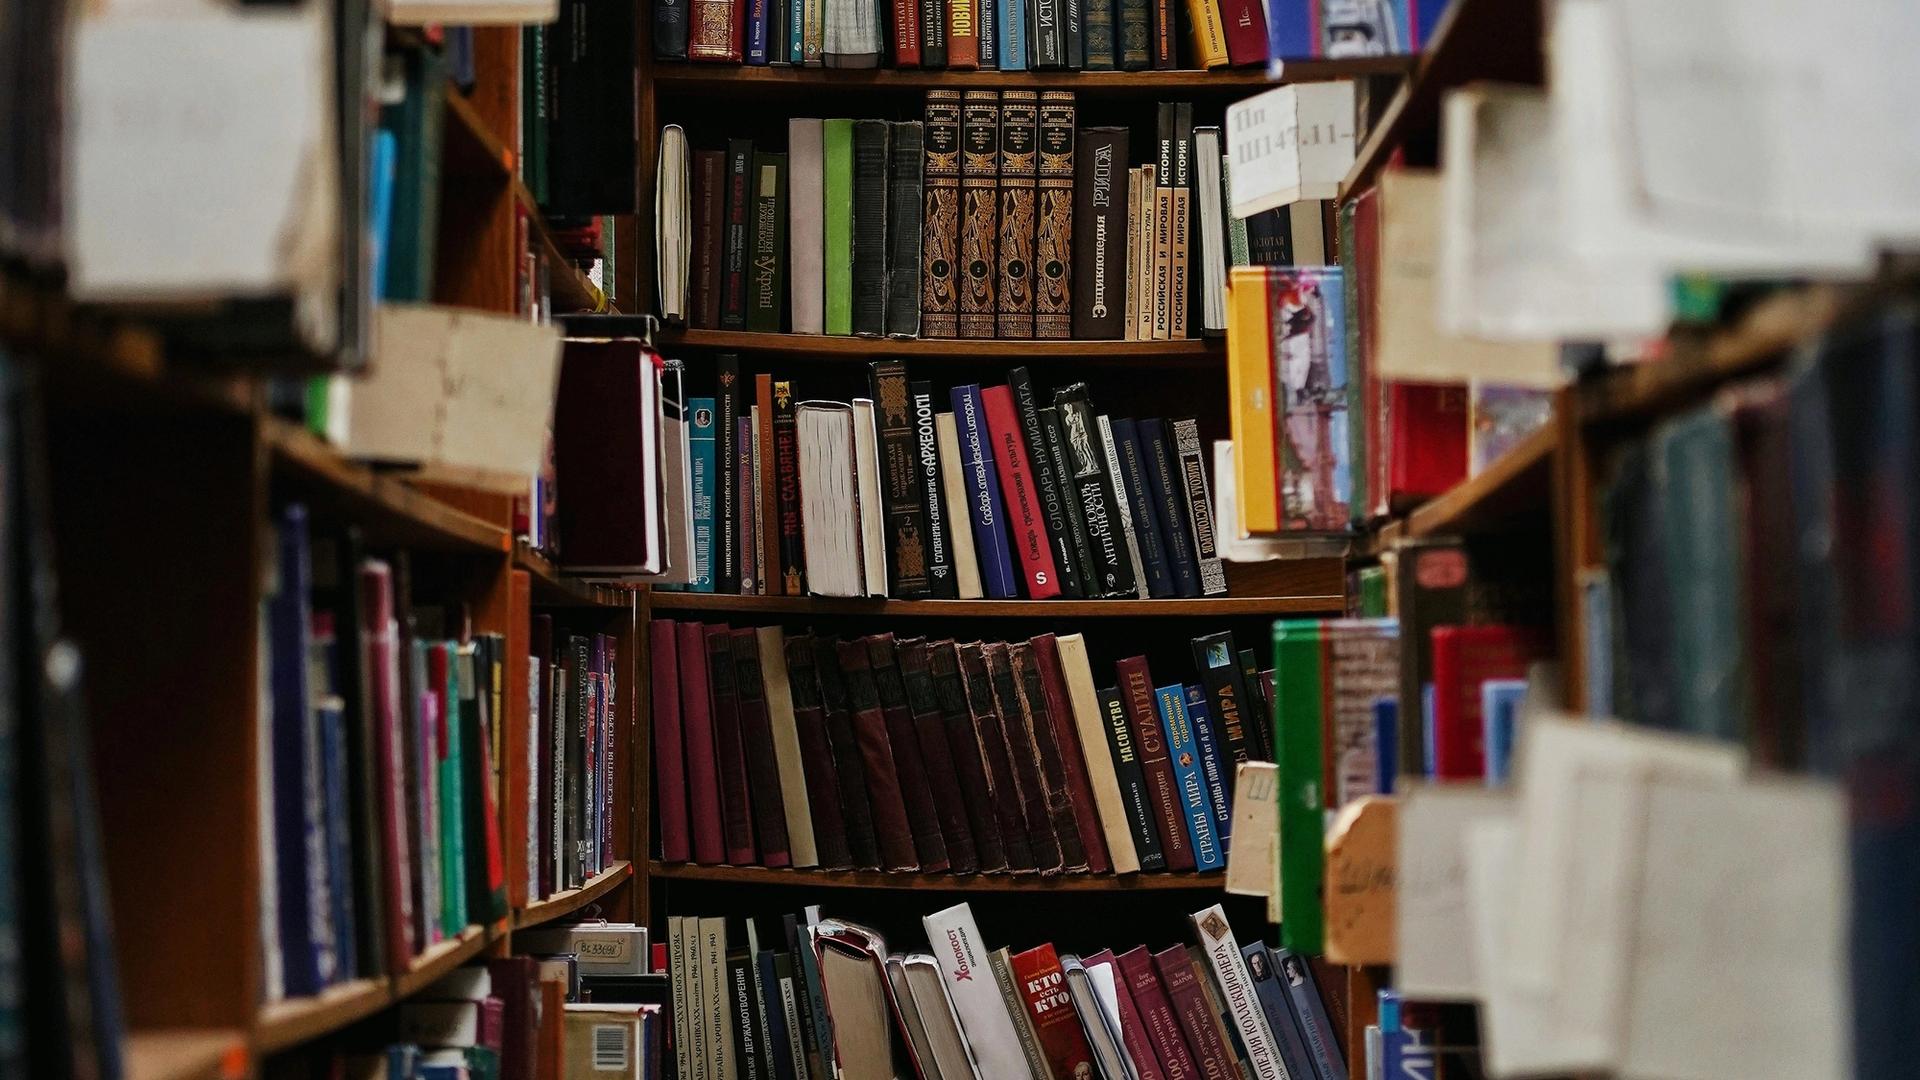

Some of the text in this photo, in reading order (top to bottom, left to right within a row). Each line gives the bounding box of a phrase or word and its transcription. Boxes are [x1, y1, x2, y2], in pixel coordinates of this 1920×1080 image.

[1091, 143, 1113, 208] РИГА
[1160, 139, 1170, 185] ИСТОРИЯ
[1176, 139, 1187, 185] ИСТОРИЯ
[757, 202, 769, 254] ДУХОВНОСТІ
[766, 197, 777, 254] ПРОВІДНИКИ
[1144, 207, 1154, 231] ГУЛАГу
[1159, 196, 1169, 245] МИРОВАЯ
[1176, 196, 1185, 245] МИРОВАЯ
[1092, 215, 1108, 319] Энциклопедия
[1128, 242, 1136, 280] Справочник
[1144, 237, 1153, 276] Справочник
[755, 256, 776, 310] Україні
[1156, 265, 1167, 331] РОССИЙСКАЯ
[1173, 265, 1184, 331] РОССИЙСКАЯ
[1017, 381, 1048, 463] НУМИЗМАТА
[1047, 423, 1059, 443] СССР
[694, 457, 704, 476] МИРА
[777, 428, 796, 502] СЛАВЯНЕ!
[962, 394, 993, 526] Словарь американской истории
[1004, 432, 1021, 469] культуры
[1123, 439, 1143, 496] ИСТОРИЧЕСКИЙ
[1153, 439, 1172, 495] ИСТОРИЧЕСКИЙ
[723, 394, 733, 577] ЭНЦИКЛОПЕДИЯ РОССИЙСКОЙ ГОСУДАРСТВЕННОСТИ
[1013, 472, 1033, 527] средневековой
[1040, 467, 1064, 531] СЛОВАРЬ
[1081, 483, 1101, 537] СЛОВАРЬ
[1186, 461, 1214, 554] МИКОЛА КОСТОМАРОВ
[1090, 482, 1118, 567] АНТИЧНОСТИ
[1136, 497, 1151, 528] СЛОВАРЬ
[1165, 496, 1180, 528] СЛОВАРЬ
[1026, 530, 1041, 561] Словарь
[1108, 700, 1134, 763] МАСОНСТВО
[1161, 693, 1182, 750] современный
[1172, 694, 1190, 743] справочник
[1216, 684, 1244, 741] МИРА
[1127, 671, 1183, 850] ЭНЦИКЛОПЕДИЯ СТАЛИН
[1204, 753, 1220, 781] МИРА
[1183, 770, 1216, 864] СТРАНЫ МИРА
[1210, 783, 1230, 821] СТРАНЫ
[708, 933, 717, 947] 1943
[710, 952, 718, 965] 1941
[946, 928, 973, 982] Холокост
[957, 927, 977, 968] энциклопедия
[1026, 972, 1062, 994] КТО
[1033, 991, 1071, 1014] КТО
[1213, 943, 1256, 1035] КОЛЛЕКЦИОНЕРА
[713, 1006, 722, 1044] ХРОНІКА
[735, 967, 755, 1054] ДЕРЖАВОТВОРЕННЯ
[1160, 1005, 1181, 1046] України
[1192, 996, 1211, 1030] Україну
[794, 1041, 805, 1080] КРАЇНСЬКІ
[1205, 1030, 1217, 1047] про
[1202, 1057, 1222, 1080] 100
